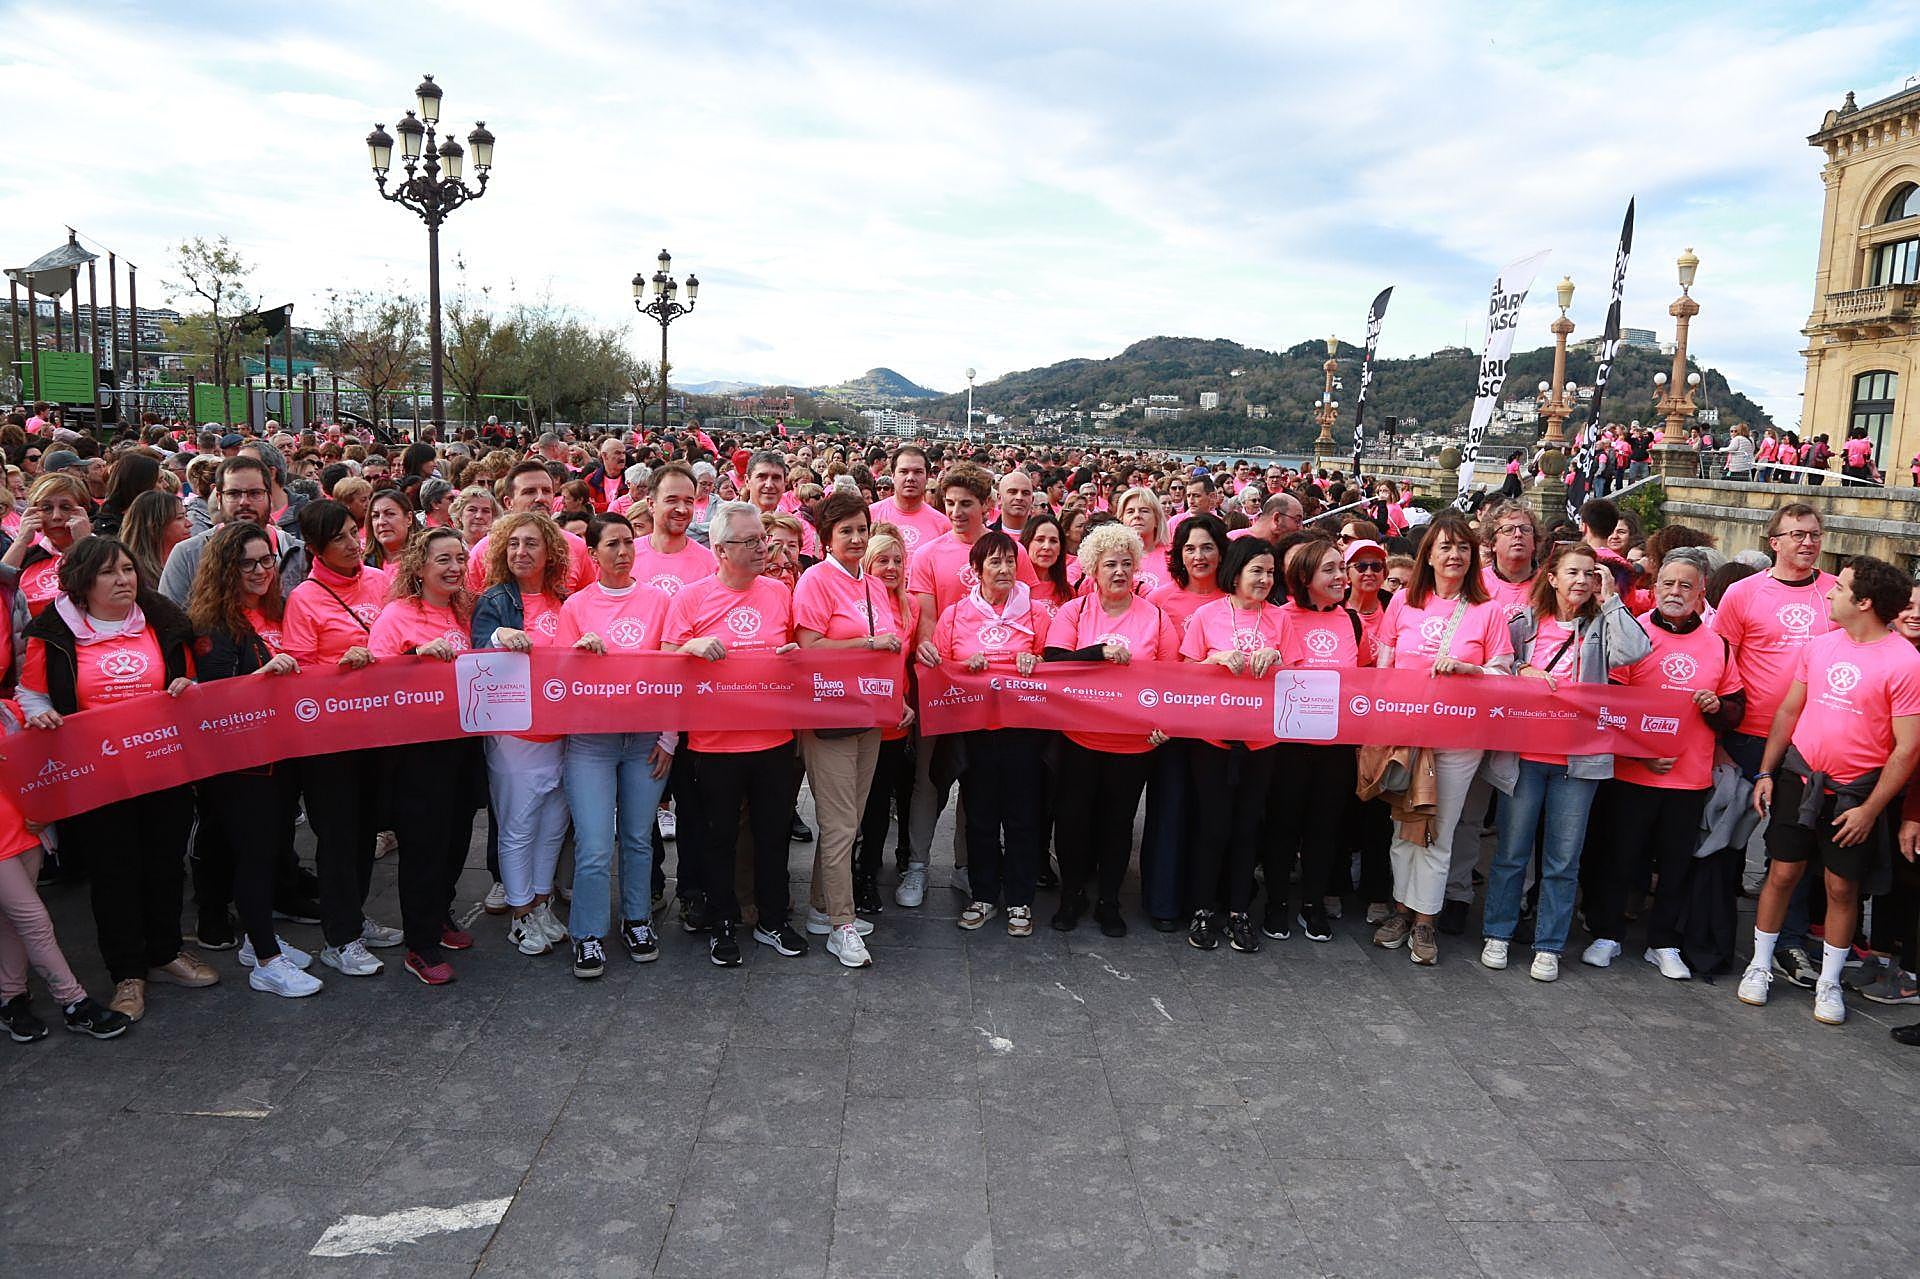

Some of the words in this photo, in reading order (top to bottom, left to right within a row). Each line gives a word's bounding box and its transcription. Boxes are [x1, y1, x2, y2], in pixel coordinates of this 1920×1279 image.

[813, 672, 824, 681] EL
[572, 681, 632, 698] Goizper
[636, 681, 683, 698] Group
[716, 681, 757, 691] Fundación
[813, 680, 844, 690] DIARIO
[861, 679, 892, 695] Kaiku
[1005, 679, 1047, 691] EROSKI
[813, 689, 845, 698] VASCO
[1017, 694, 1047, 704] zurekin
[1163, 691, 1216, 707] Goizper
[1220, 692, 1263, 709] Group
[325, 695, 390, 713] Goizper
[394, 690, 445, 706] Group
[928, 694, 984, 708] APALATEGUI
[1375, 698, 1429, 717] Goizper
[1433, 701, 1476, 718] Group
[1508, 708, 1547, 718] Fundación
[1600, 706, 1609, 715] EL
[1643, 717, 1676, 731] Kaiku
[122, 725, 179, 749] EROSKI
[145, 742, 183, 759] zurekin
[19, 763, 96, 794] APALATEGUI
